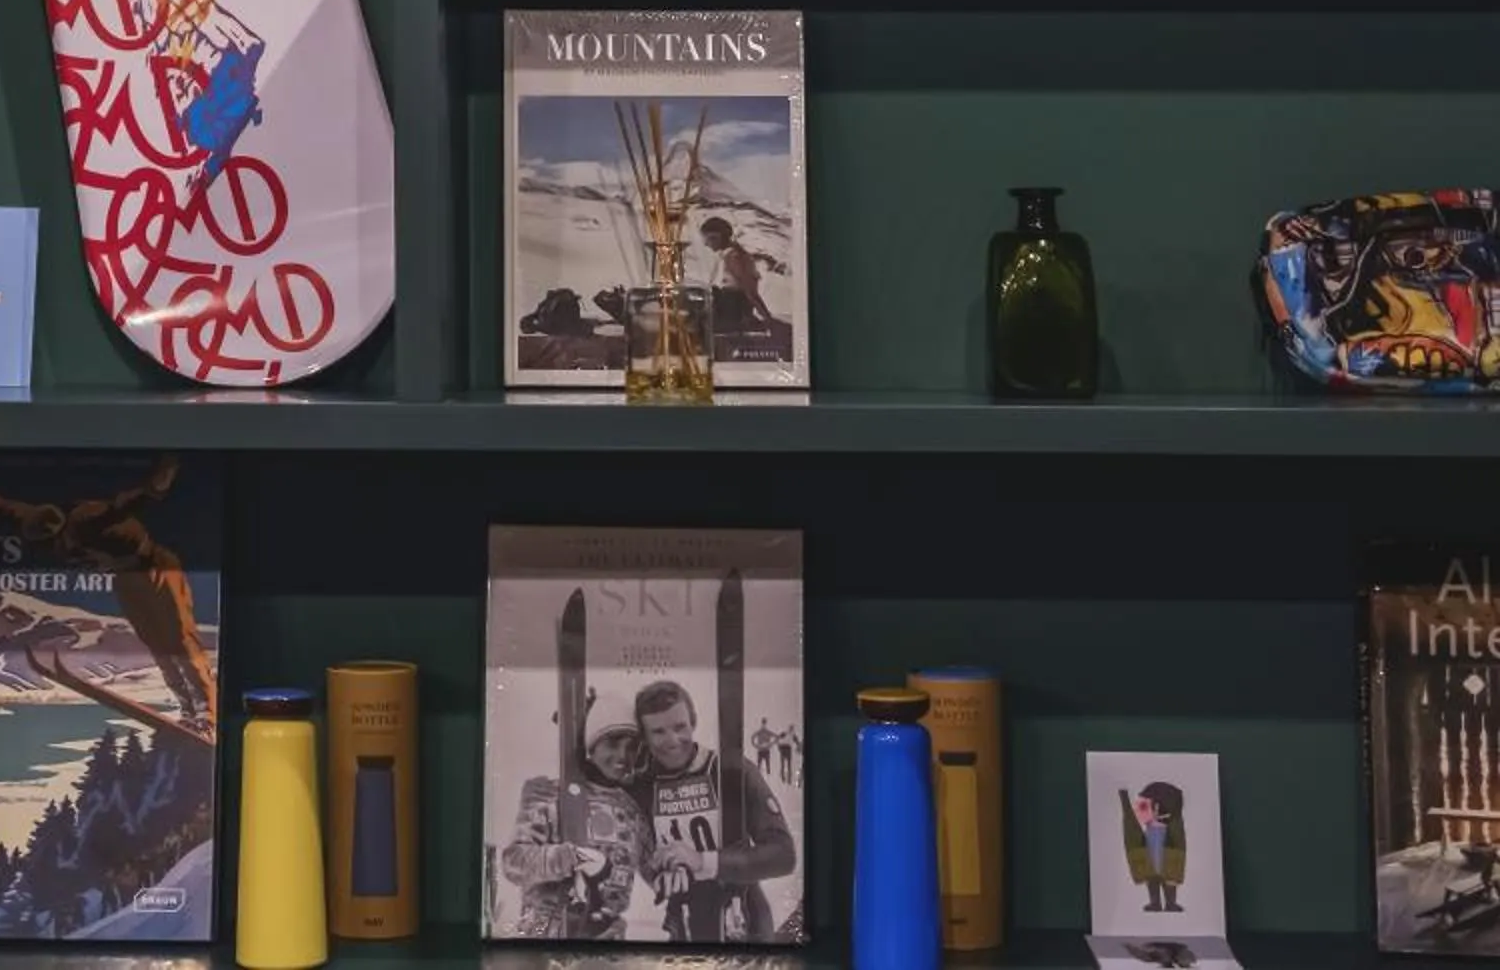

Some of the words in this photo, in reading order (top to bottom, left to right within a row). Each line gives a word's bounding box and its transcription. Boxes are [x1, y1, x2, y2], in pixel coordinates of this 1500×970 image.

[546, 32, 768, 62] MOUNTAINS
[72, 572, 117, 593] ART
[597, 576, 694, 618] SKI
